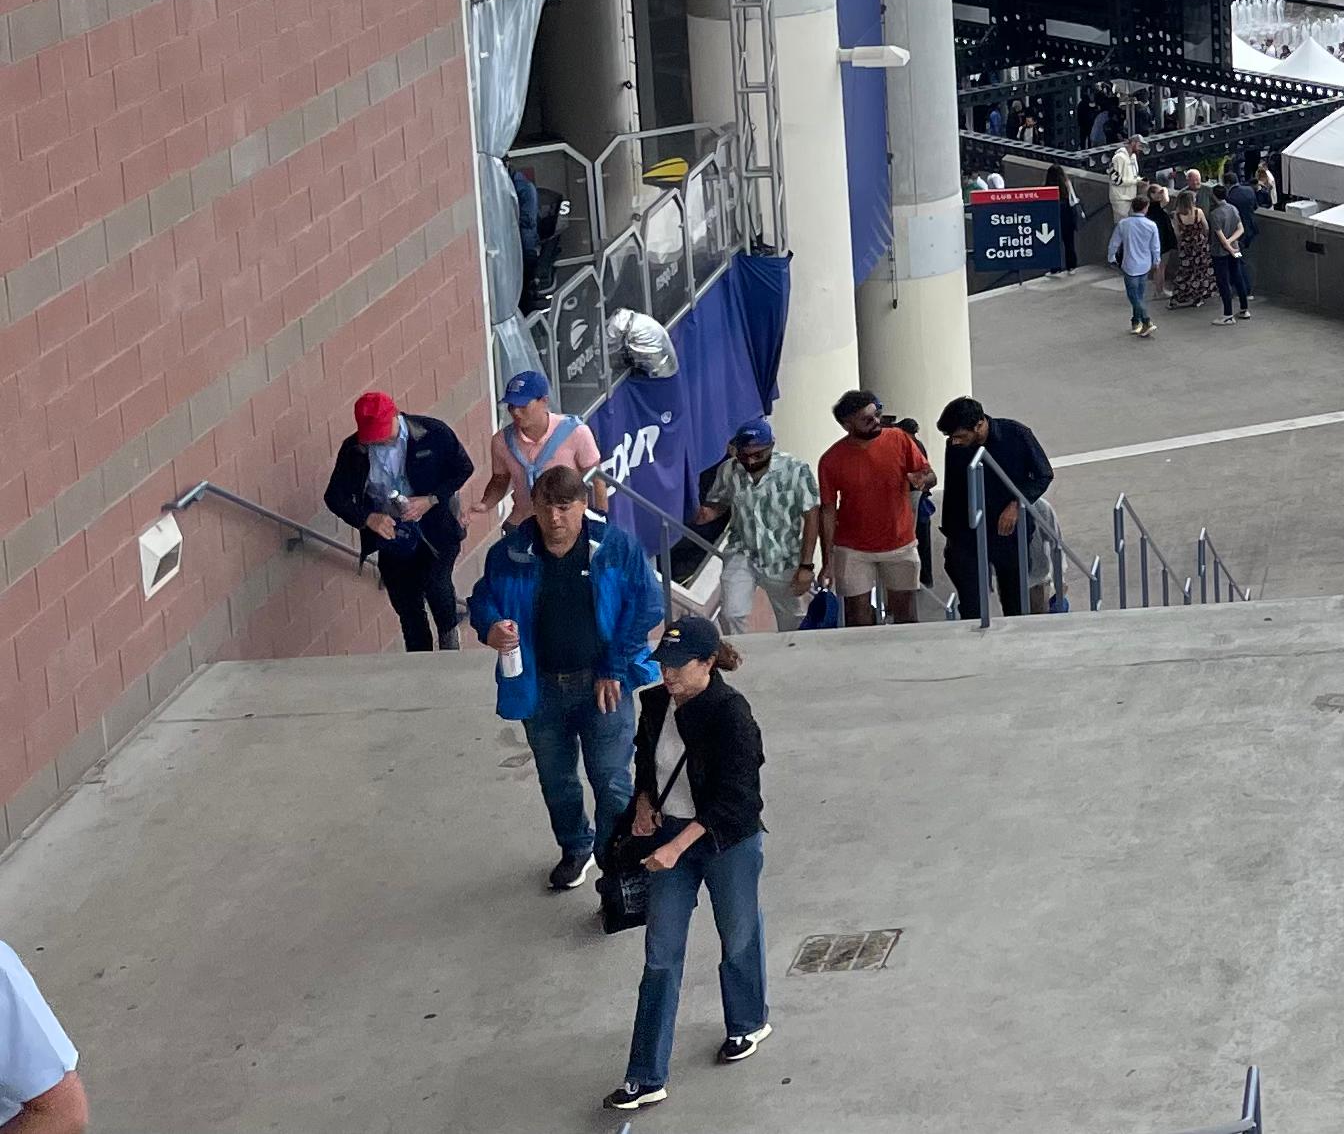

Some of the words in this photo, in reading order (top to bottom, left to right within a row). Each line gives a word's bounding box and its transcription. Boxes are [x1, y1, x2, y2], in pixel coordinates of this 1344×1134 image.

[1014, 192, 1039, 200] LEVEL
[990, 213, 1032, 226] Stairs
[1017, 225, 1032, 235] to
[999, 236, 1033, 247] Field
[985, 248, 1033, 260] Courts
